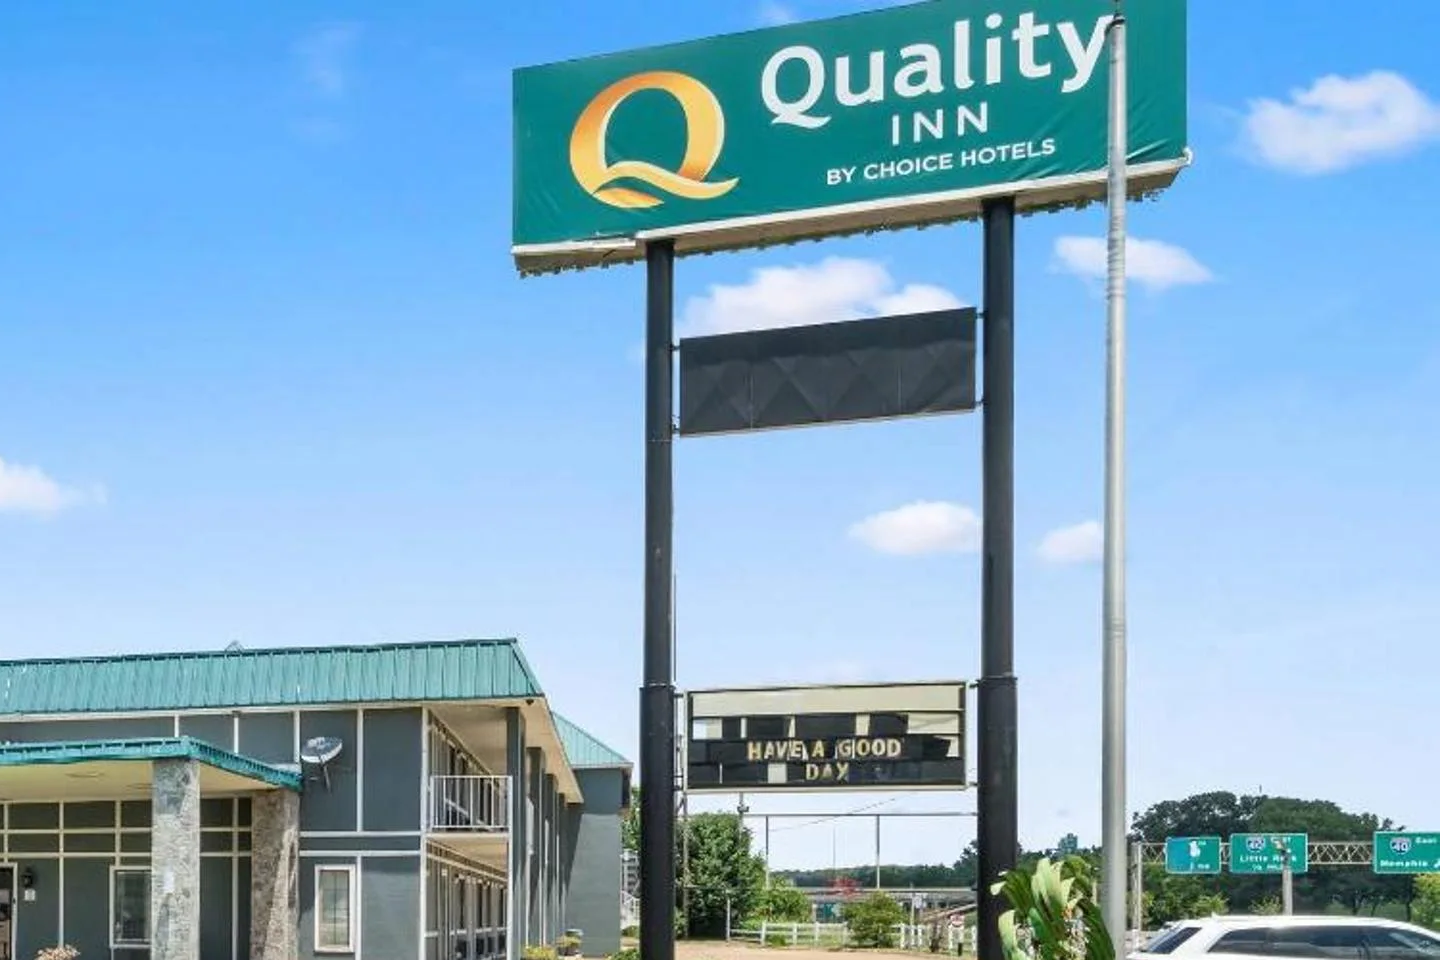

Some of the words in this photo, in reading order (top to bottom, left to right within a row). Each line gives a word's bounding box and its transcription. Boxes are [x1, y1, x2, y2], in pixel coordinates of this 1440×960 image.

[761, 12, 1116, 129] Quality
[569, 71, 741, 209] Q
[891, 101, 989, 146] INN
[826, 167, 857, 186] BY
[863, 153, 954, 180] CHOICE
[960, 138, 1057, 168] HOTELS
[747, 739, 804, 761] HAVE
[811, 740, 825, 757] A
[838, 738, 902, 758] GOOD
[805, 762, 850, 781] DAY
[1380, 859, 1428, 868] Memphis
